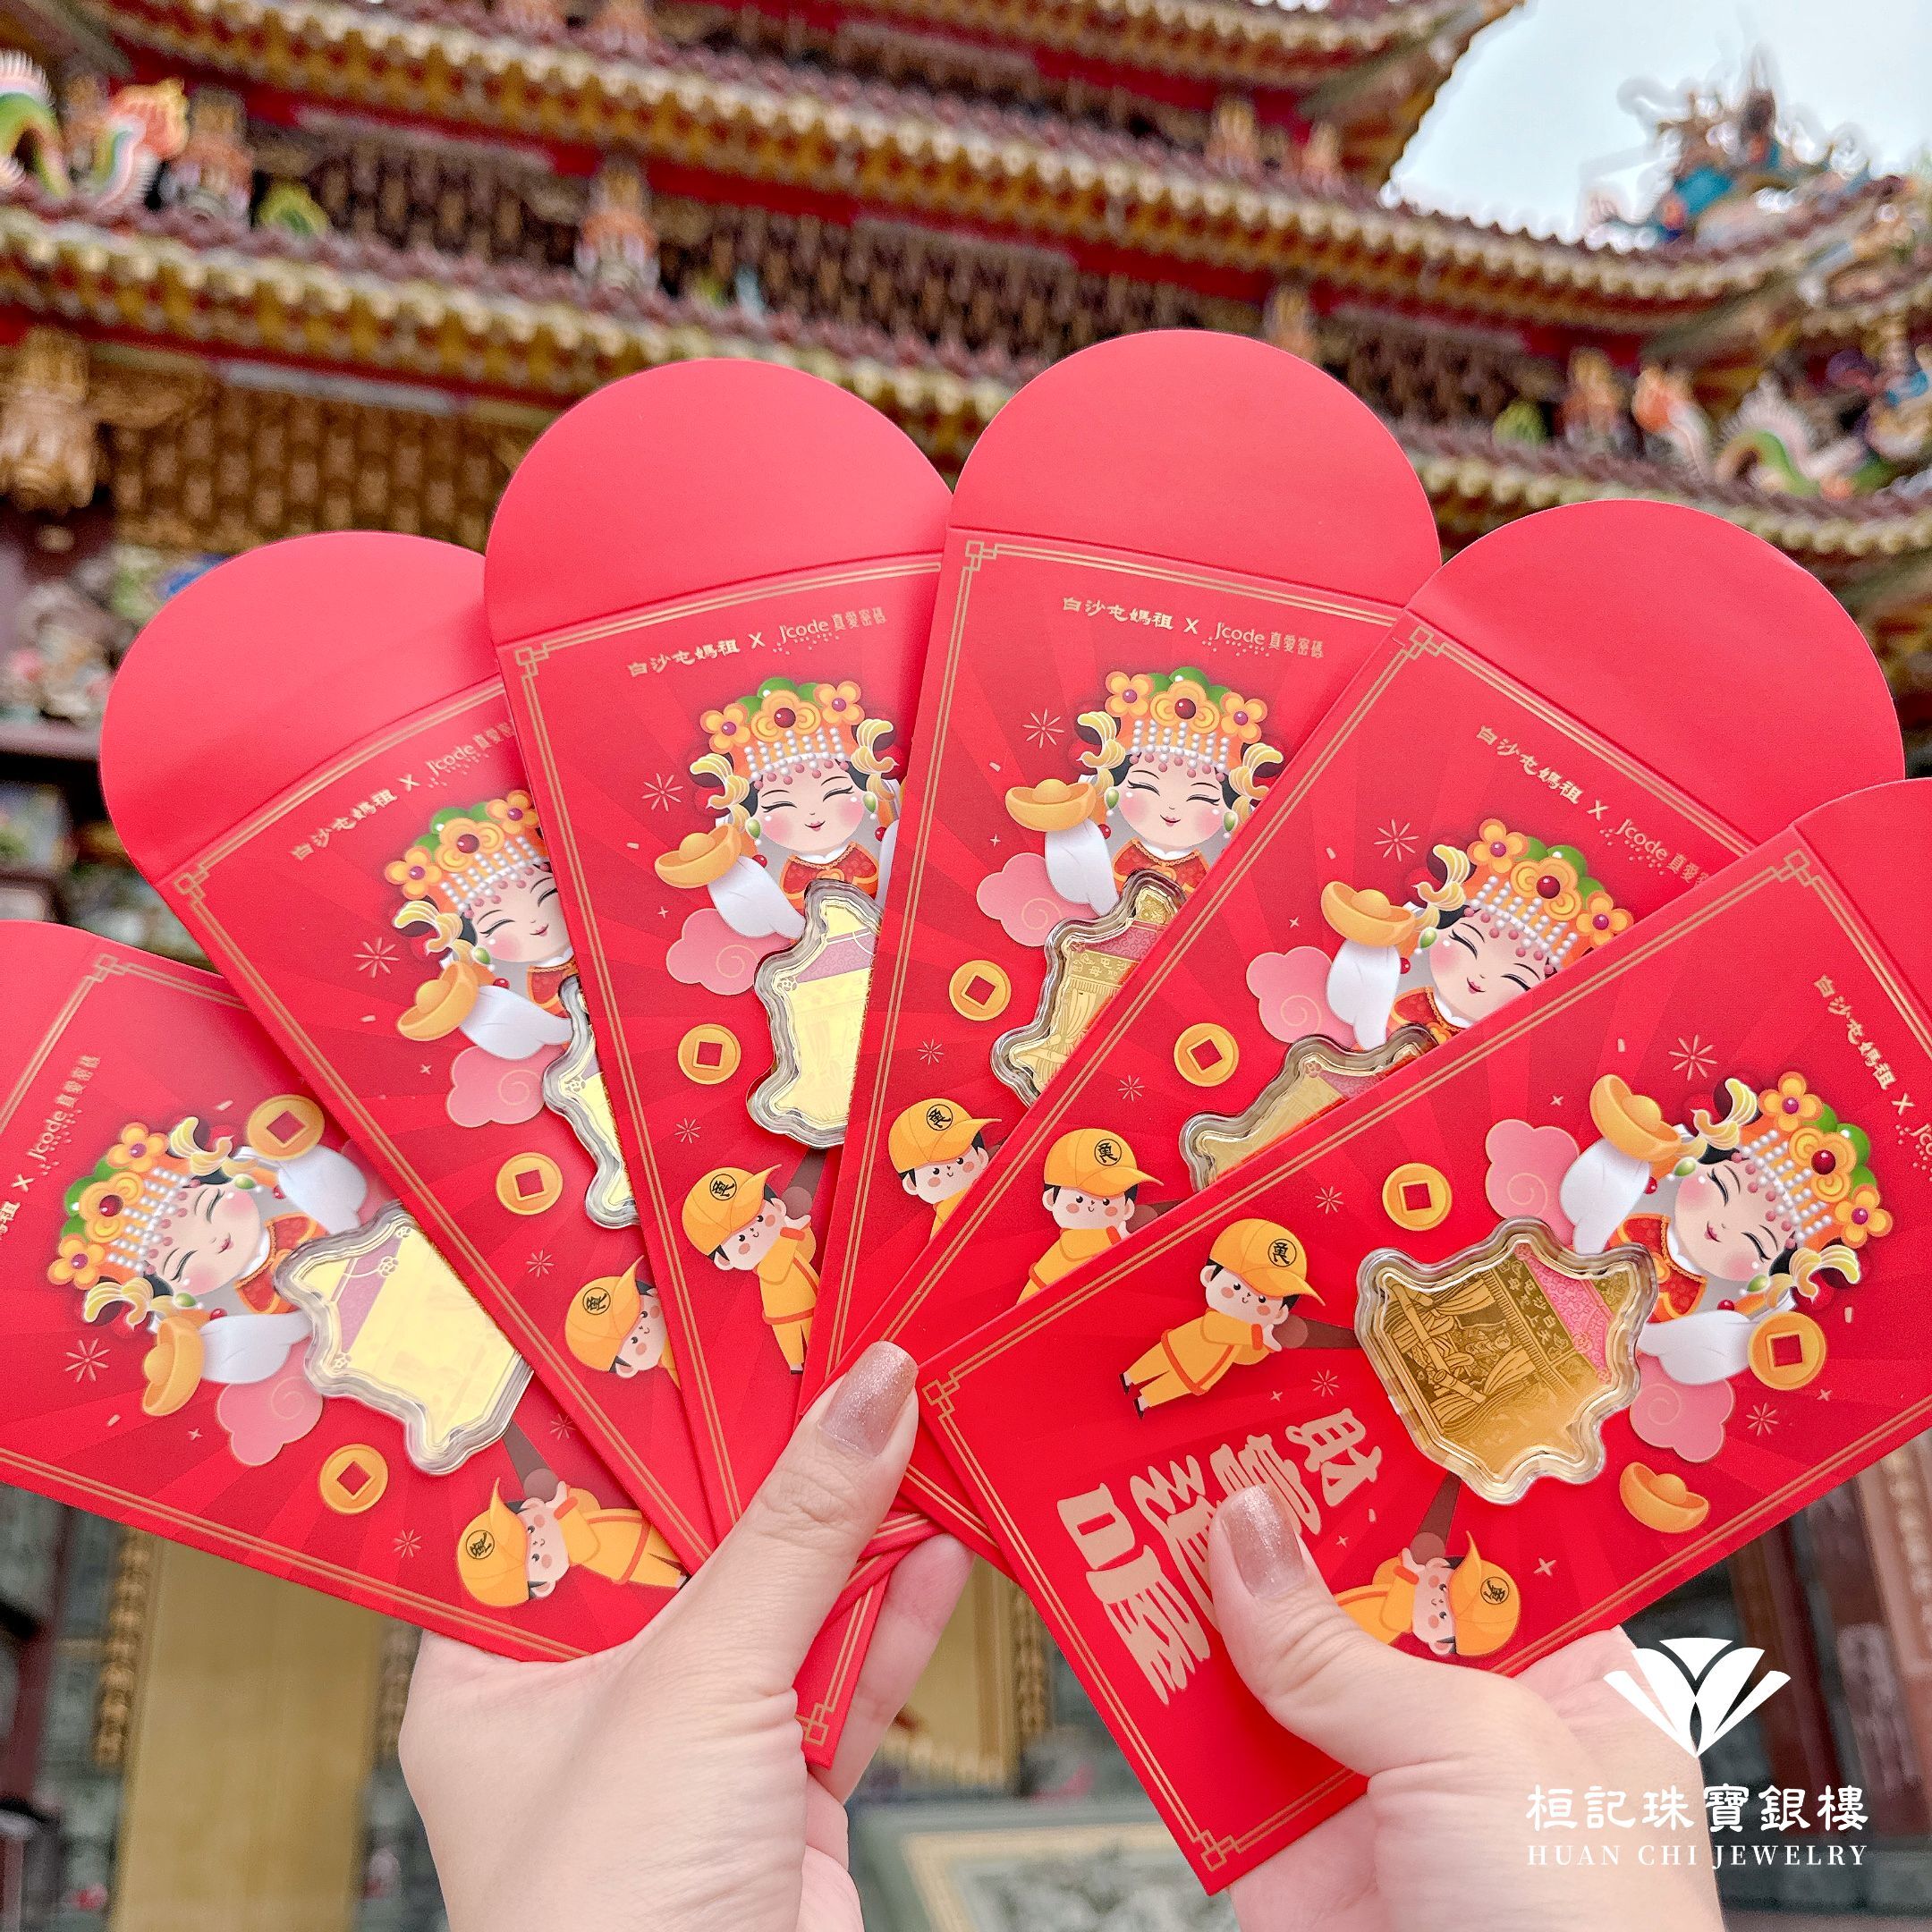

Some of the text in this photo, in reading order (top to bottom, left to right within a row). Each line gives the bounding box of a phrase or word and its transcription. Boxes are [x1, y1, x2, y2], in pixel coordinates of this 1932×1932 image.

[1063, 597, 1174, 631] 白沙屯媽祖
[628, 639, 740, 677] 白沙屯媽祖
[1476, 725, 1583, 804] 白沙屯媽祖
[291, 789, 397, 861] 白沙屯媽祖
[1814, 973, 1896, 1090] 白沙屯媽祖
